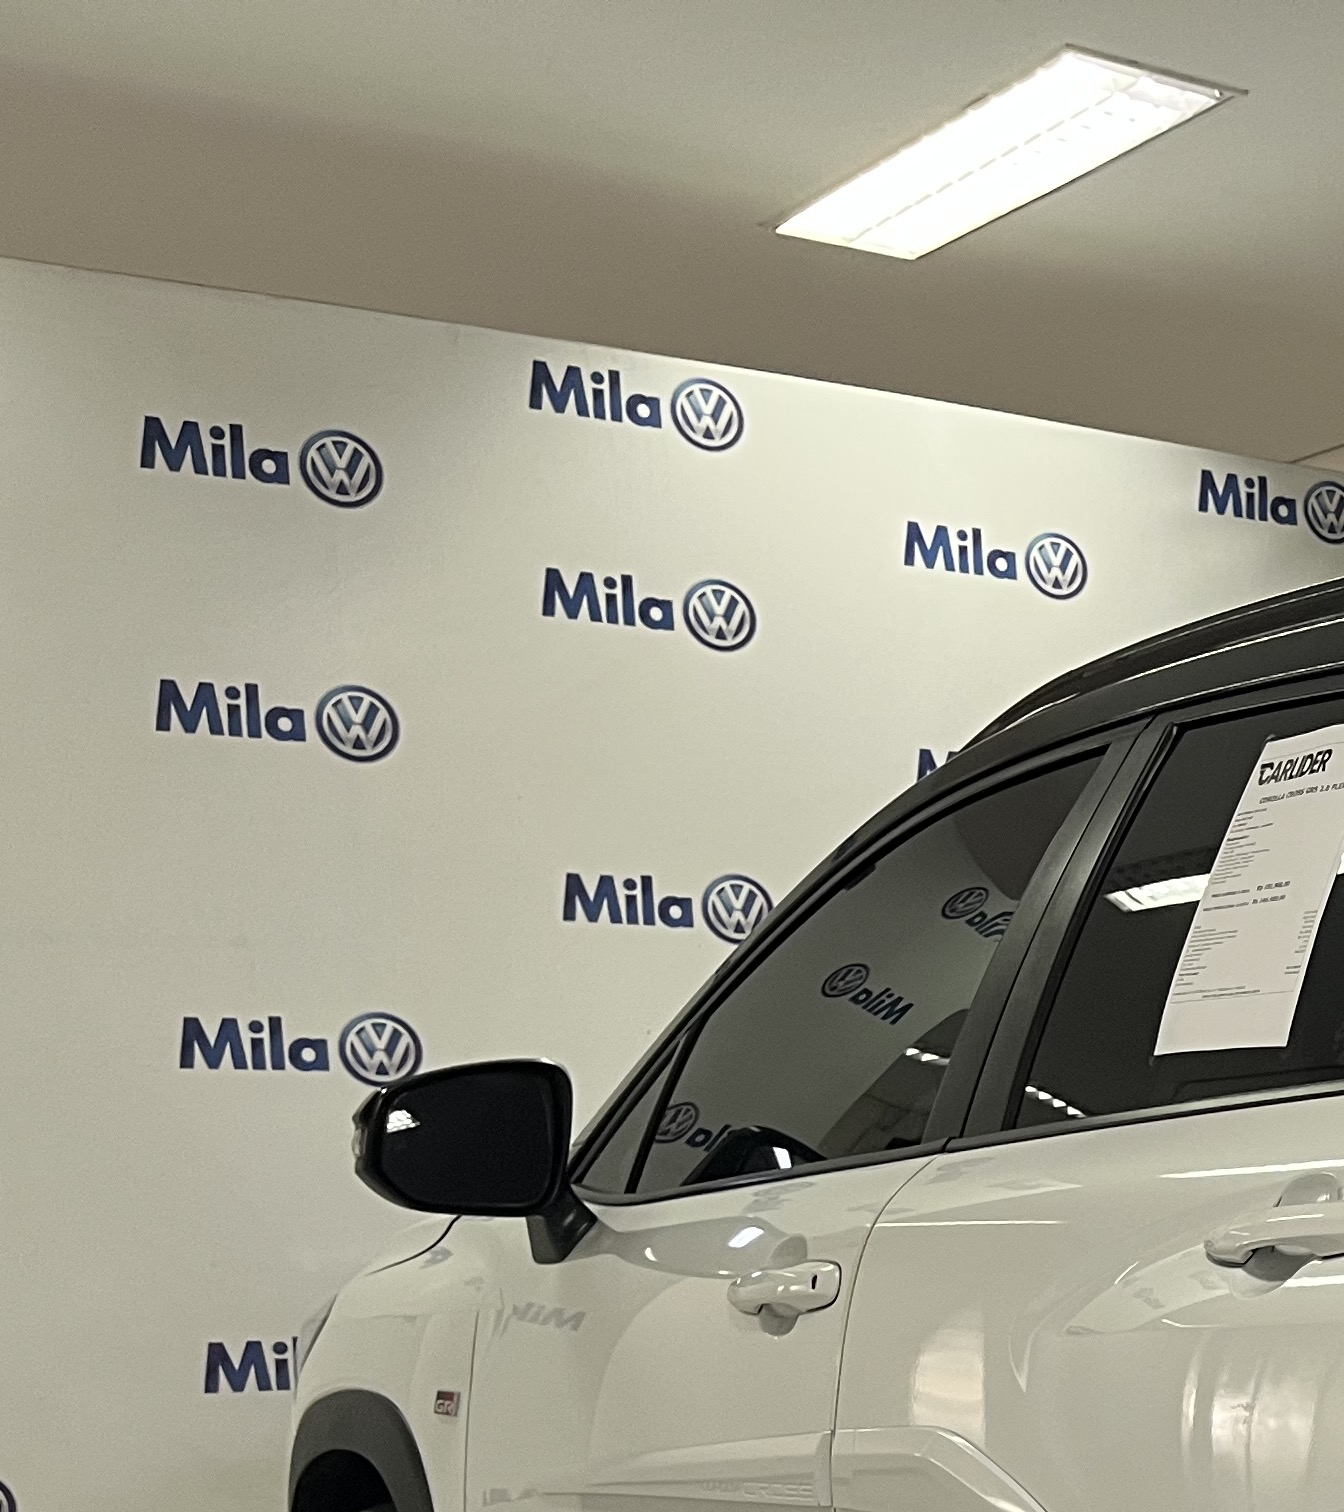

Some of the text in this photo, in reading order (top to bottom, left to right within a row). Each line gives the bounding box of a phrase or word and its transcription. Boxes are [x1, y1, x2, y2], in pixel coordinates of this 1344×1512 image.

[529, 360, 662, 428] Mila
[140, 416, 290, 485] Mila
[1199, 468, 1297, 526] Mila
[904, 521, 1017, 580] Mila
[542, 568, 674, 631] Mila
[156, 679, 306, 742] Mila
[1258, 749, 1334, 786] CARLIDER
[563, 873, 694, 928] Mila
[180, 1016, 329, 1071] Mila
